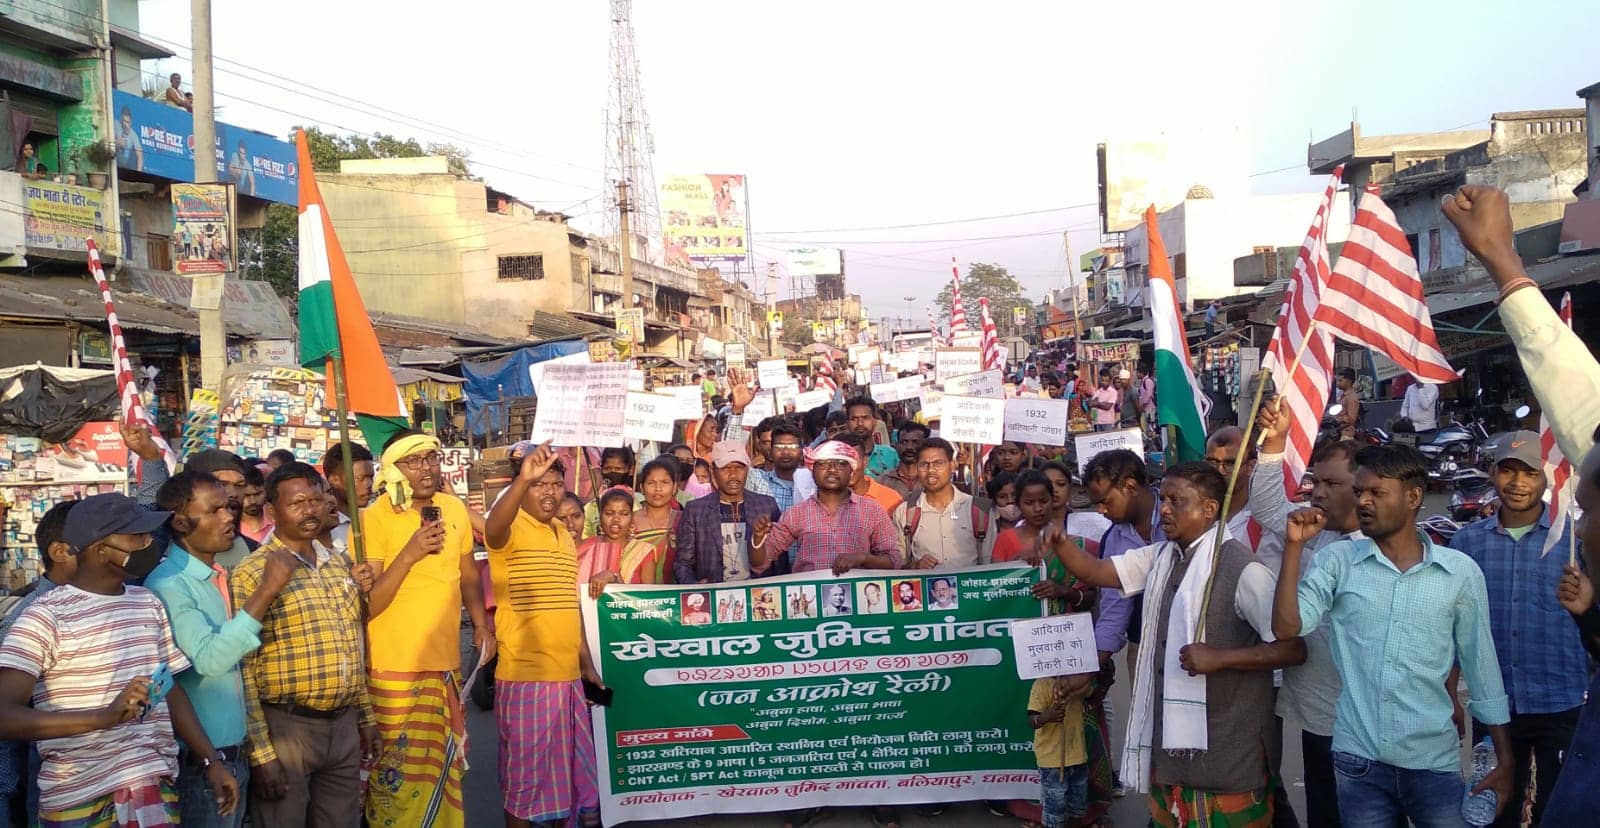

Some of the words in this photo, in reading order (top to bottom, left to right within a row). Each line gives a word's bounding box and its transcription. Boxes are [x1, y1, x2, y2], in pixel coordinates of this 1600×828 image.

[632, 402, 656, 414] 1932
[1025, 409, 1047, 419] 1932
[1089, 436, 1126, 449] आदिवासी
[962, 591, 980, 600] जय
[610, 612, 628, 621] जय
[1031, 620, 1074, 636] आदिवासी
[609, 633, 765, 661] खेरवाल
[770, 620, 895, 659] जुमिद
[903, 615, 1013, 642] गांवत
[1027, 639, 1065, 657] मुलवासी
[1069, 636, 1083, 649] को
[697, 688, 760, 707] (जन
[767, 677, 879, 702] आक्रोश
[883, 671, 952, 694] रैली)
[621, 731, 669, 745] मुख्य
[625, 750, 656, 761] 1932
[659, 745, 715, 759] खतियान
[719, 742, 773, 756] आधारित
[776, 738, 825, 752] स्थानिय
[828, 734, 850, 748] एवं
[852, 731, 905, 746] नियोजन
[908, 729, 939, 743] निति
[942, 730, 974, 743] लागु
[975, 728, 1009, 740] करो।
[626, 761, 684, 775] झारखण्ड
[686, 758, 700, 771] के
[704, 759, 713, 768] 9
[716, 756, 746, 768] भाषा
[757, 756, 765, 765] 5
[769, 750, 834, 765] जनजातिय
[837, 746, 857, 760] एवं
[860, 748, 868, 758] 4
[871, 745, 909, 759] क्षेत्रिय
[912, 744, 942, 756] भाषा
[953, 742, 974, 754] को
[976, 743, 1007, 755] लागु
[628, 776, 654, 786] CNT
[658, 774, 679, 783] Act
[690, 771, 715, 781] SPT
[718, 769, 740, 779] Act
[743, 766, 784, 780] कानून
[788, 765, 806, 775] का
[810, 760, 848, 775] सख्ती
[852, 759, 864, 772] से
[868, 761, 906, 772] पालन
[909, 758, 930, 769] हो।
[620, 790, 697, 806] आयोजक
[716, 783, 779, 799] खेरवाल
[784, 780, 832, 797] जुमिद
[835, 777, 891, 791] गांवता,
[897, 773, 976, 789] बलियापुर,
